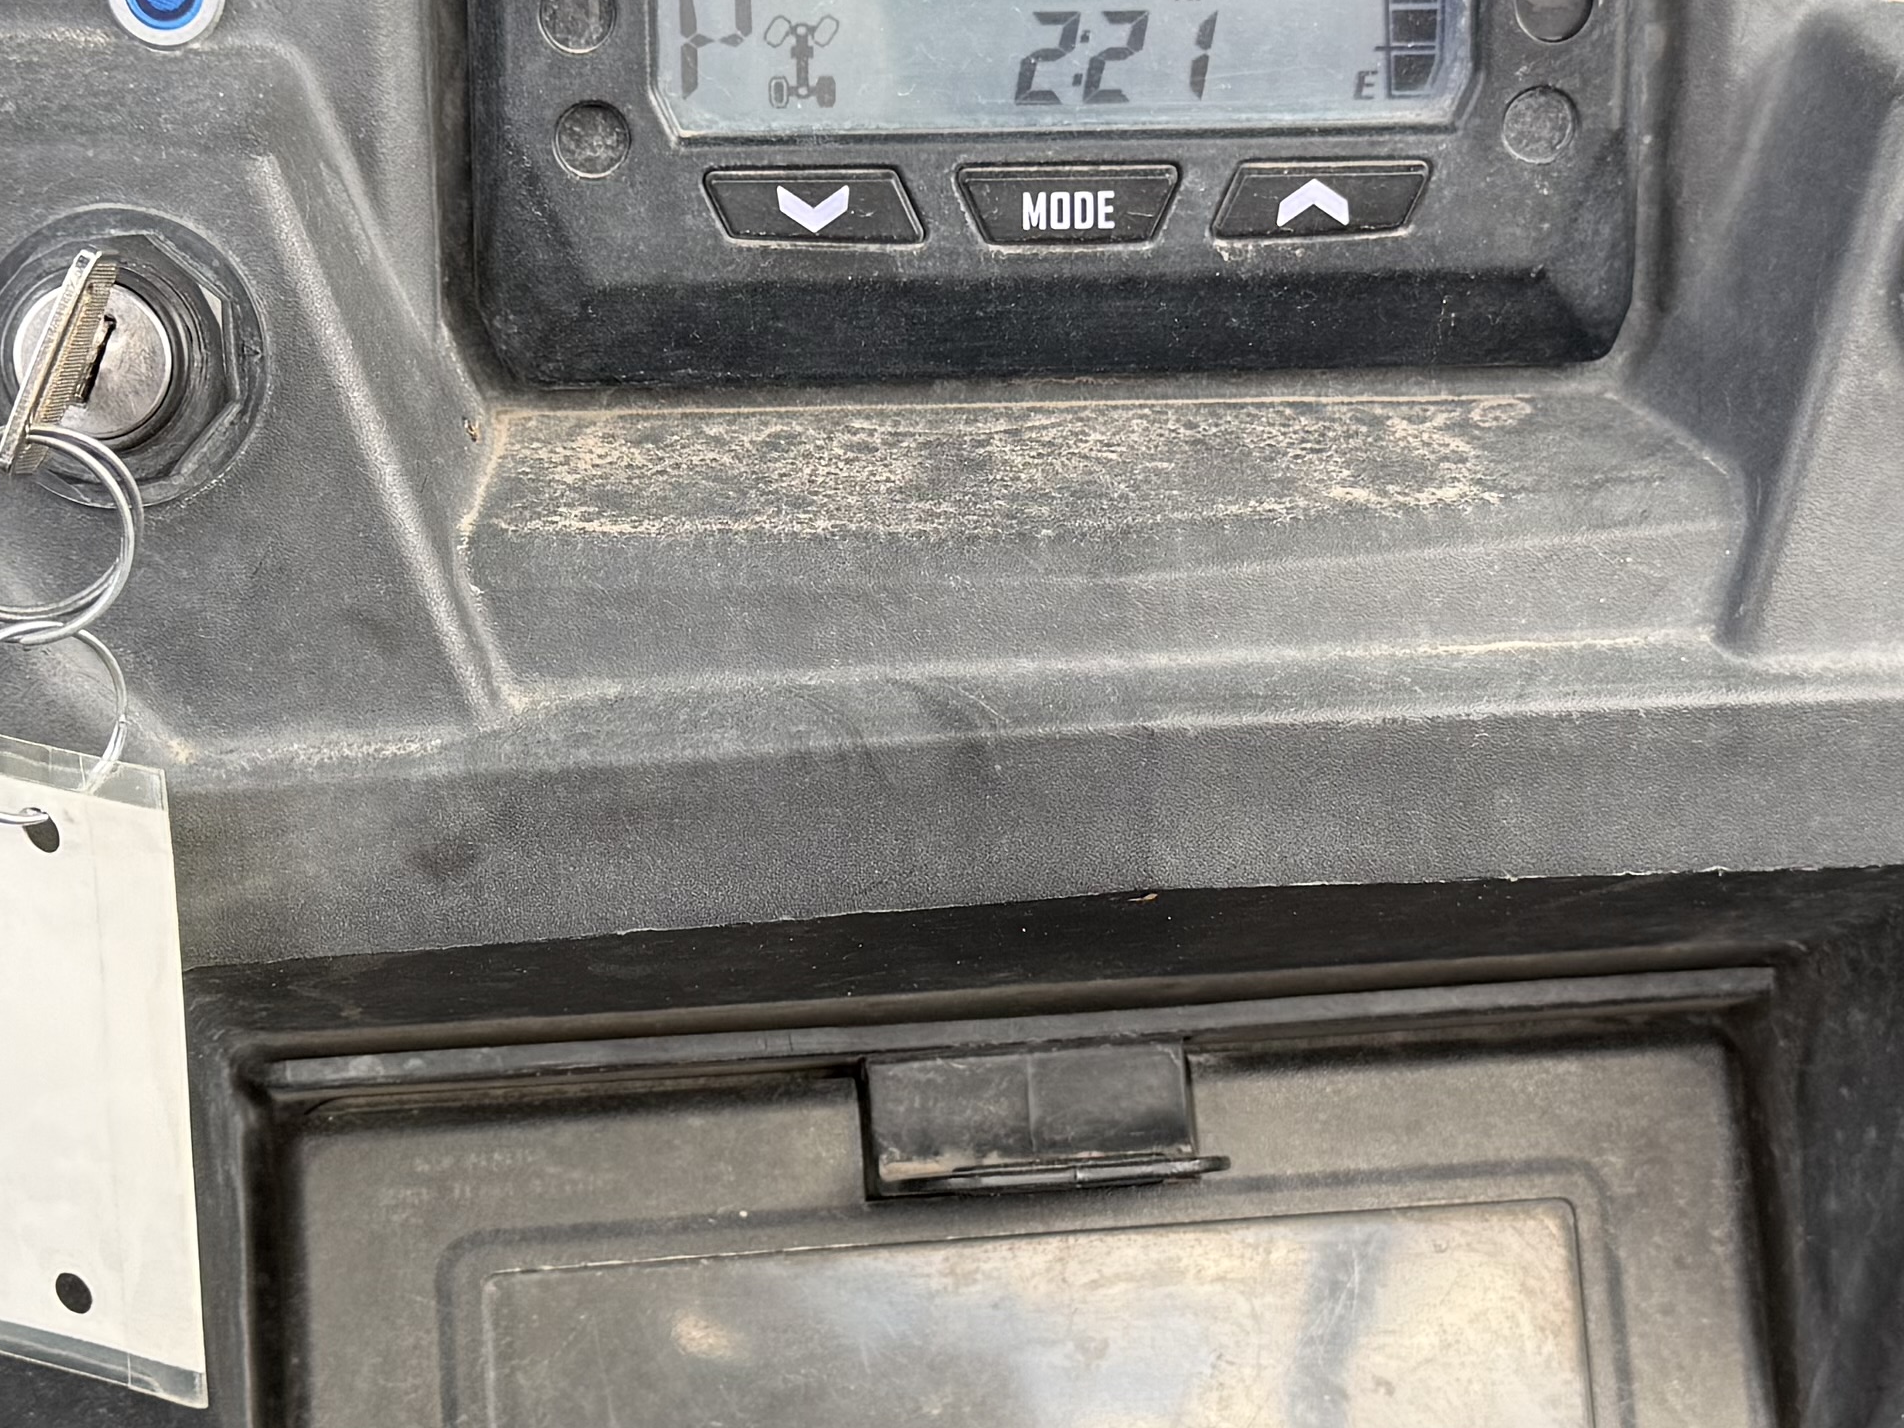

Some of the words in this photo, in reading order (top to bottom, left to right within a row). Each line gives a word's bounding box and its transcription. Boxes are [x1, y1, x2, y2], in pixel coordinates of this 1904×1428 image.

[1014, 9, 1219, 106] 2:21
[1353, 70, 1376, 100] E
[1019, 191, 1117, 232] MODE
